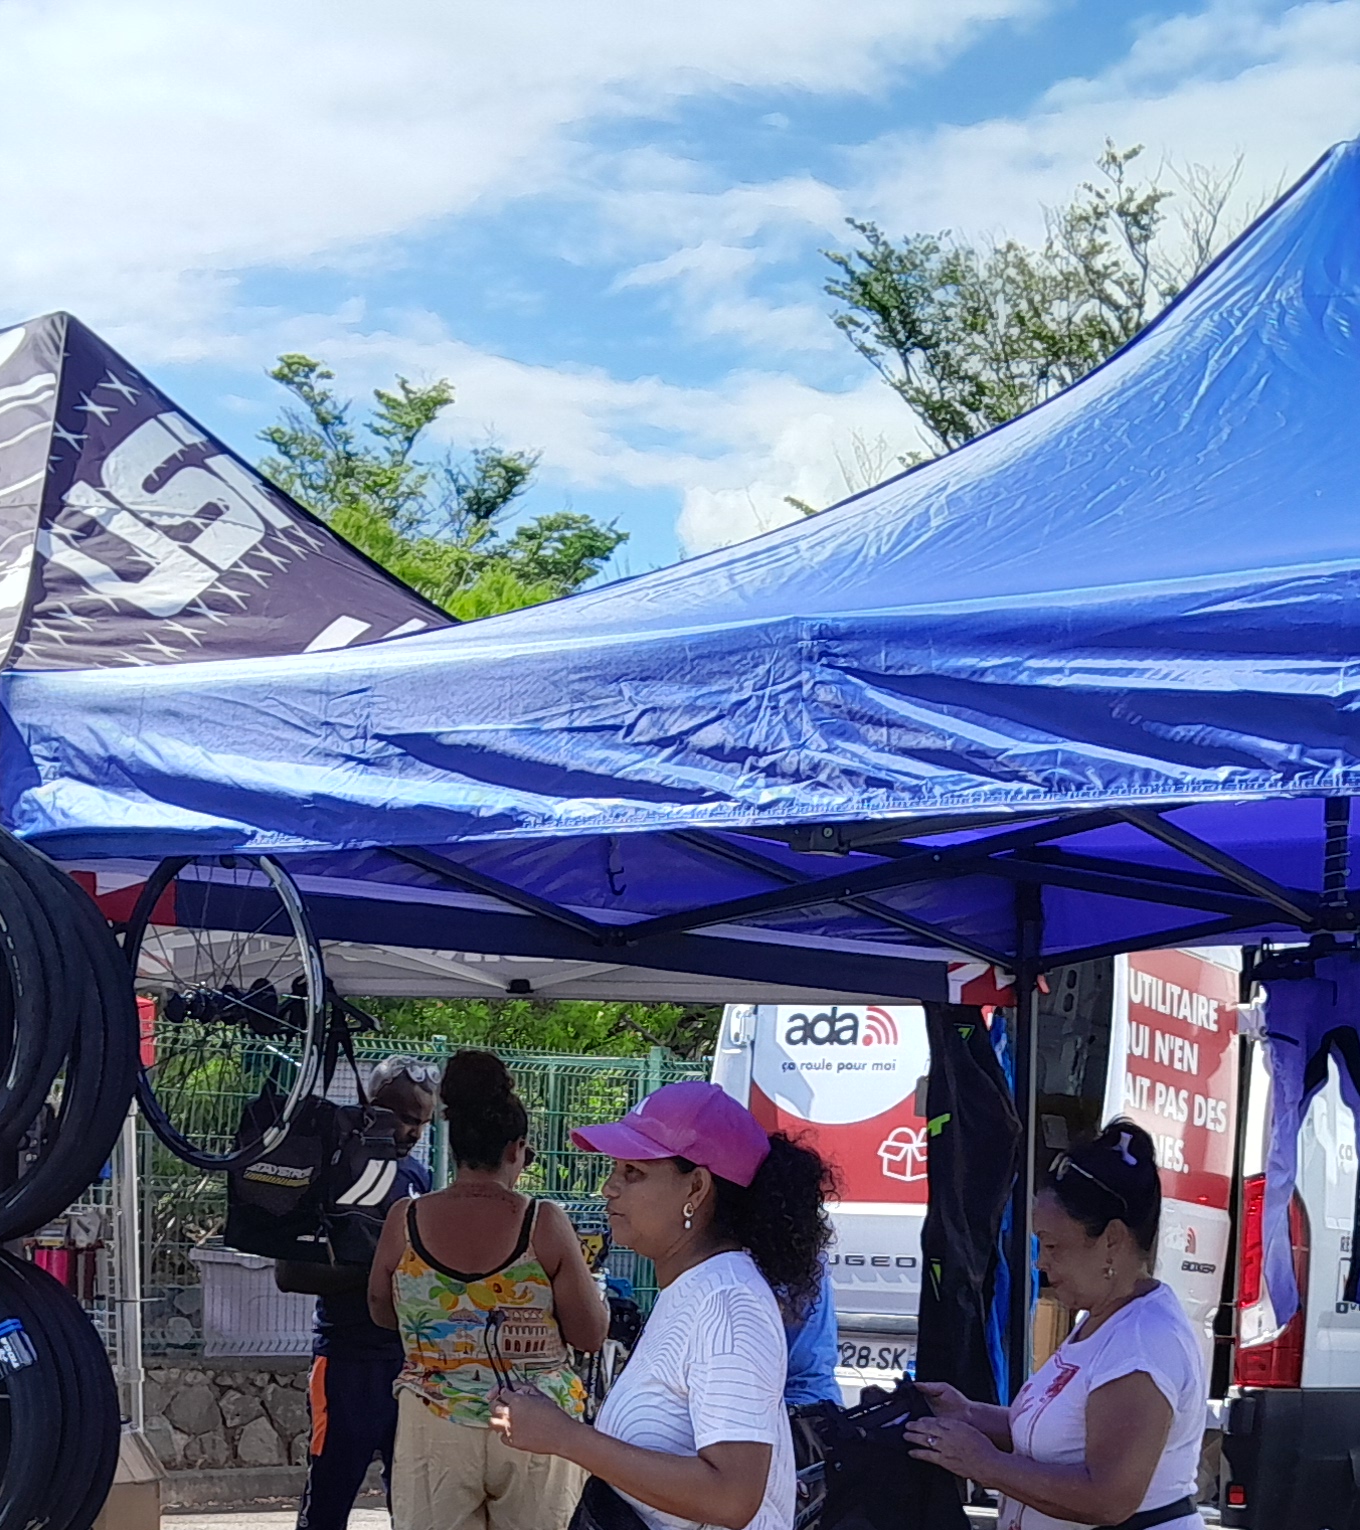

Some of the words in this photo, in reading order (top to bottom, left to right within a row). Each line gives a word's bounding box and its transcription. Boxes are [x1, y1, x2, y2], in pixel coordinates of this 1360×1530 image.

[785, 1006, 859, 1045] ada
[1128, 967, 1219, 1032] UTILITAIRE
[800, 1058, 833, 1071] roule
[836, 1061, 868, 1074] pour
[871, 1058, 897, 1071] moi
[1126, 1021, 1150, 1060] UI
[1154, 1029, 1200, 1075] N'EN
[1124, 1071, 1152, 1111] AIT
[1154, 1081, 1189, 1124] PAS
[1193, 1094, 1228, 1134] DES
